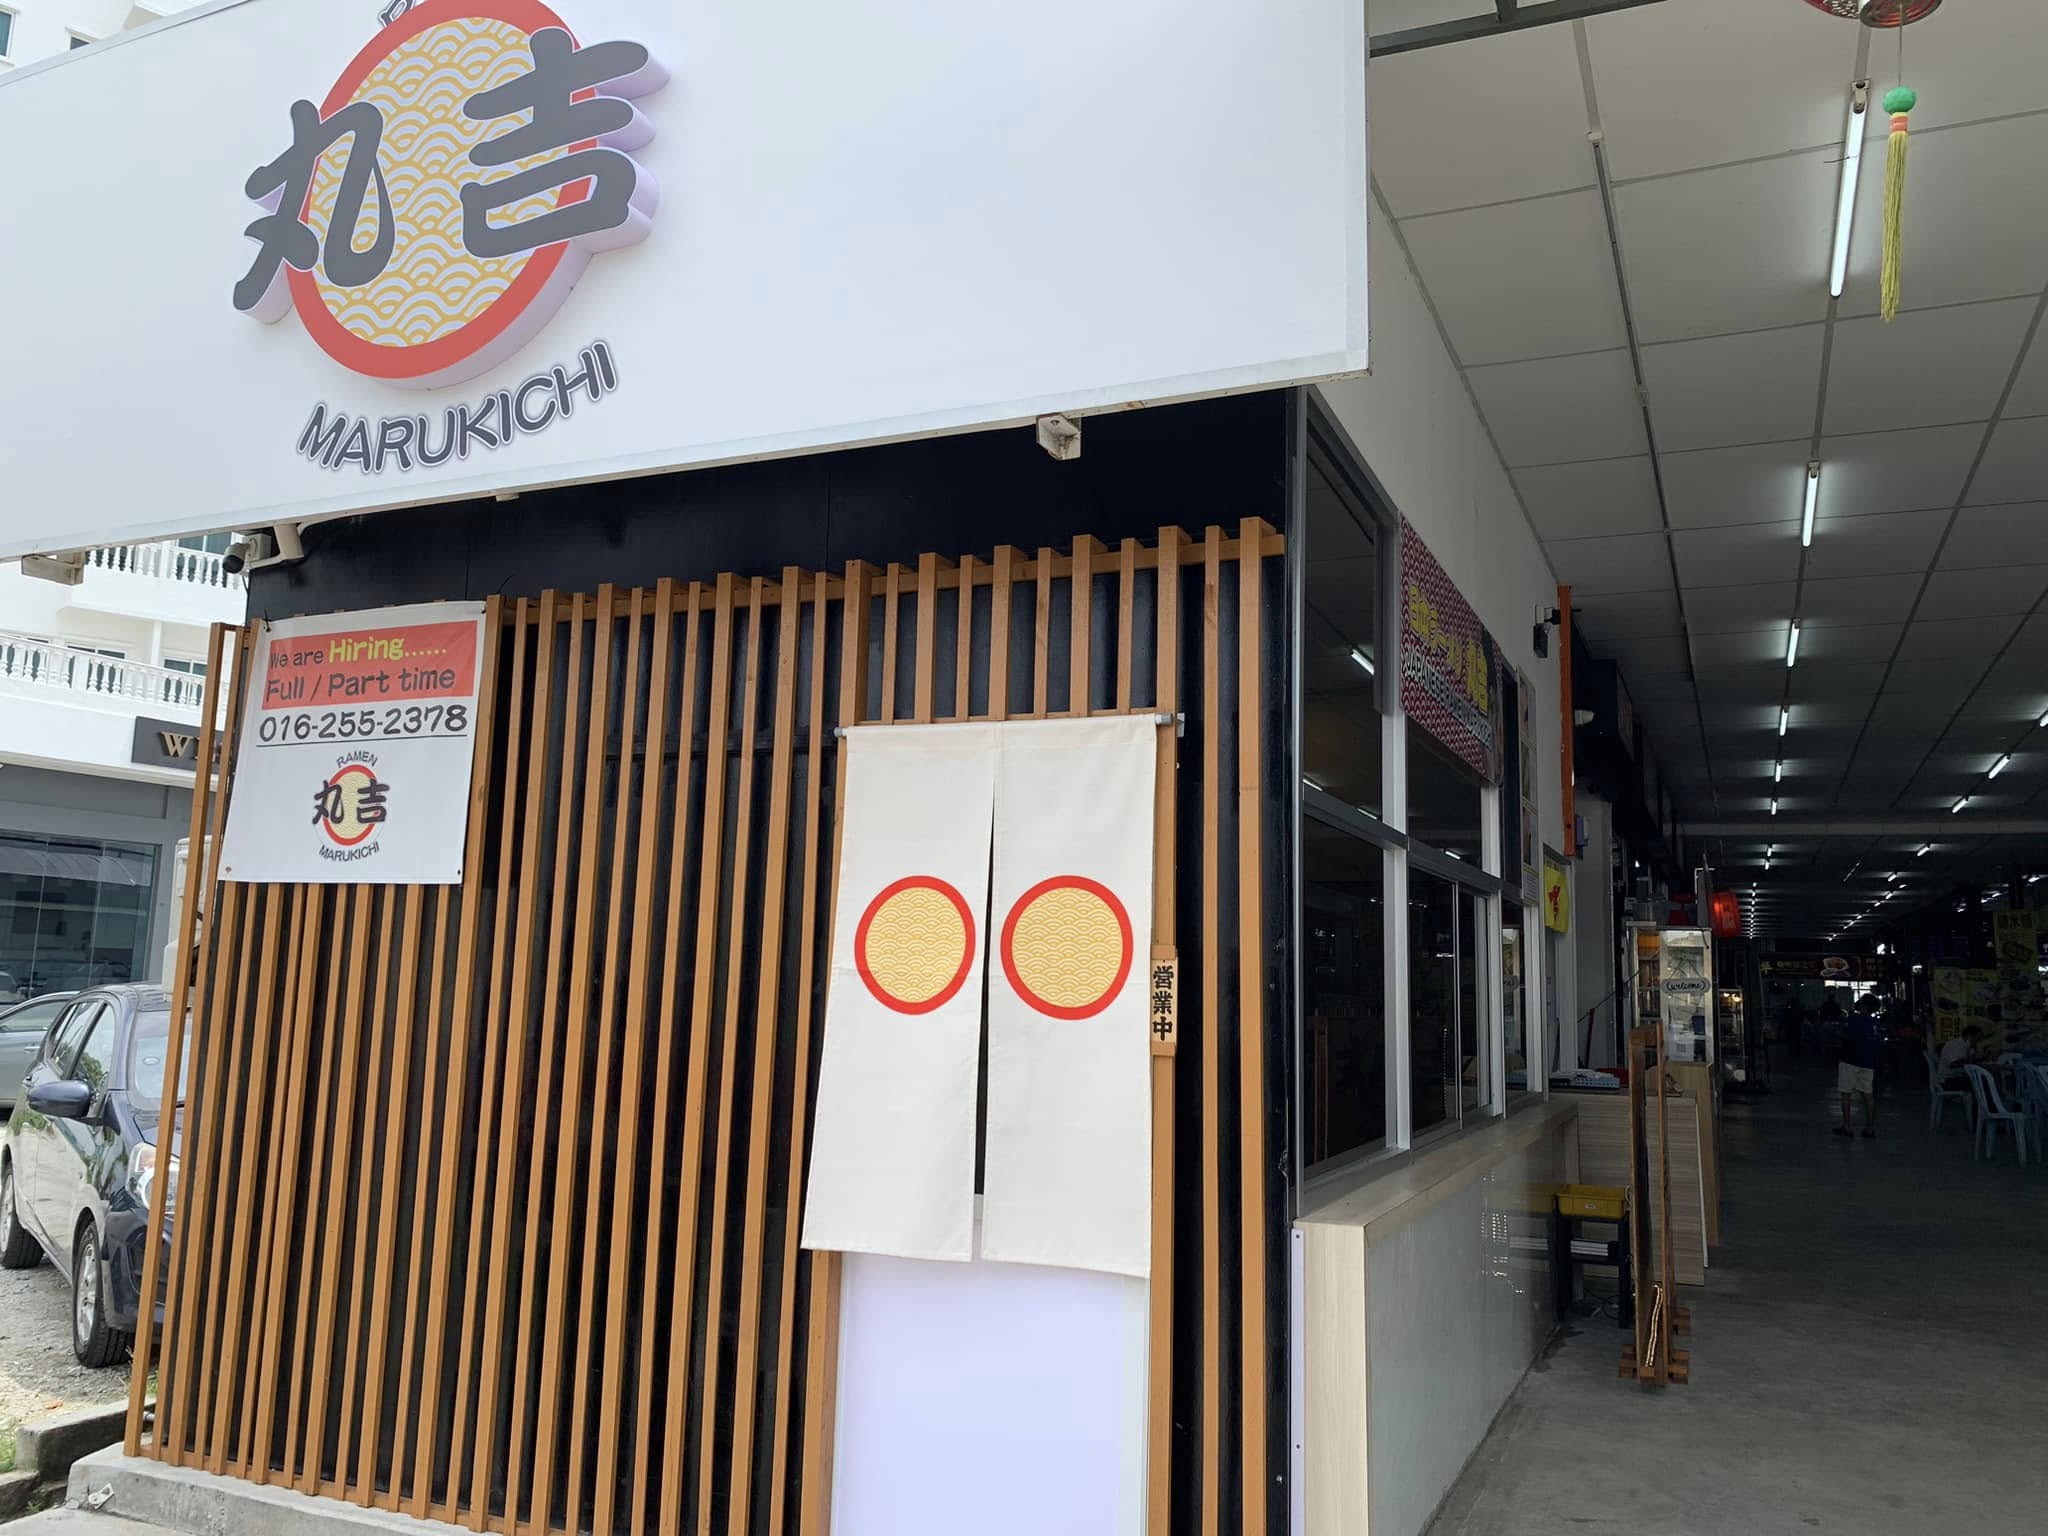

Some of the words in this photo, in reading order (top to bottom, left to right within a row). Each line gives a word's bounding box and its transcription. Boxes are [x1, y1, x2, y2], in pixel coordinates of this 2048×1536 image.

[232, 26, 649, 311] 丸吉
[298, 341, 618, 474] MARUKICHI
[270, 651, 288, 669] We
[293, 649, 324, 666] are
[1405, 651, 1445, 708] JAPANESE
[266, 676, 304, 703] Full
[328, 669, 390, 698] Part
[401, 666, 456, 692] time
[259, 704, 468, 743] 016-255-2378
[335, 750, 379, 769] RAMEN
[311, 778, 392, 826] 丸吉
[318, 840, 380, 863] MARUKICHI
[1152, 965, 1174, 1041] 営業中
